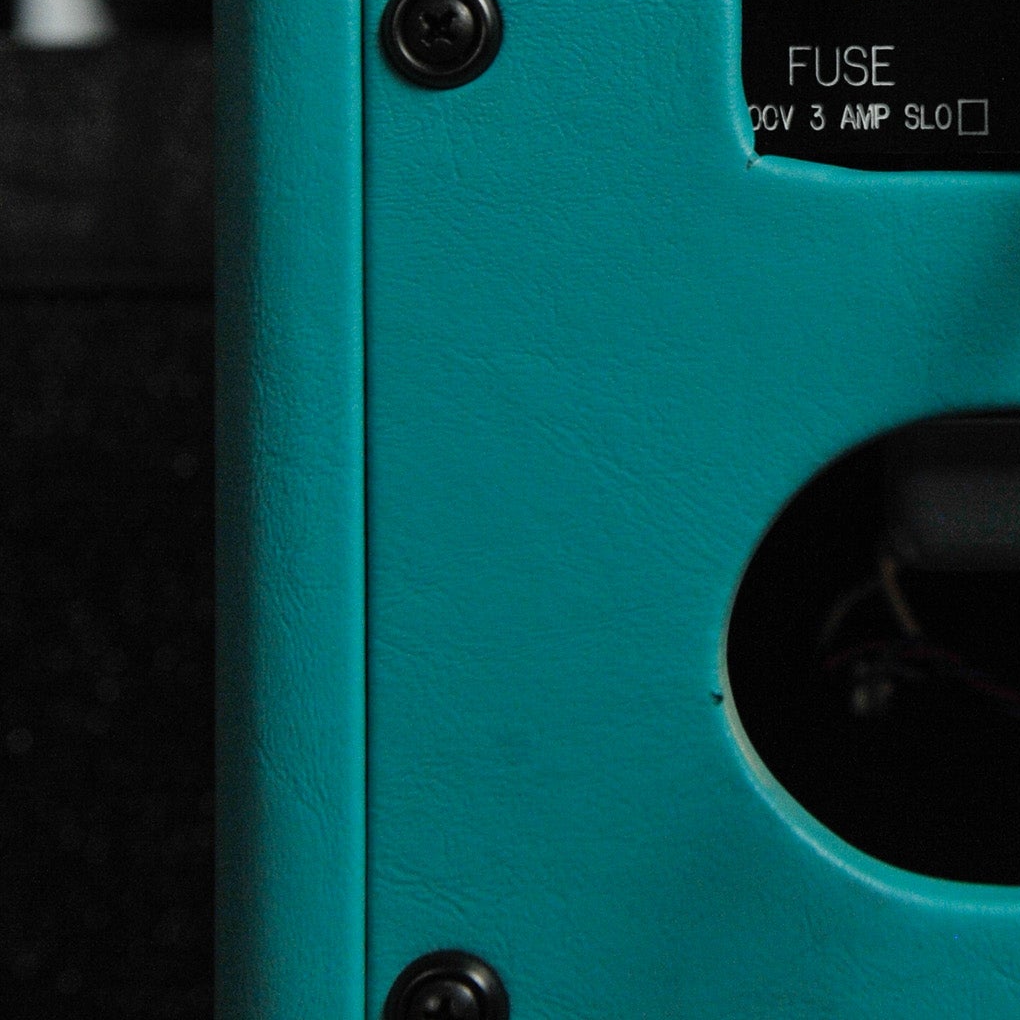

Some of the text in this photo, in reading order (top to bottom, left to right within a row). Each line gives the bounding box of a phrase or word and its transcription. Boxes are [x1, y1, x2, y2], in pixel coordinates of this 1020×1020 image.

[788, 45, 895, 87] FUSE
[809, 104, 826, 131] 3
[839, 103, 891, 131] AMP
[904, 103, 952, 130] SLO
